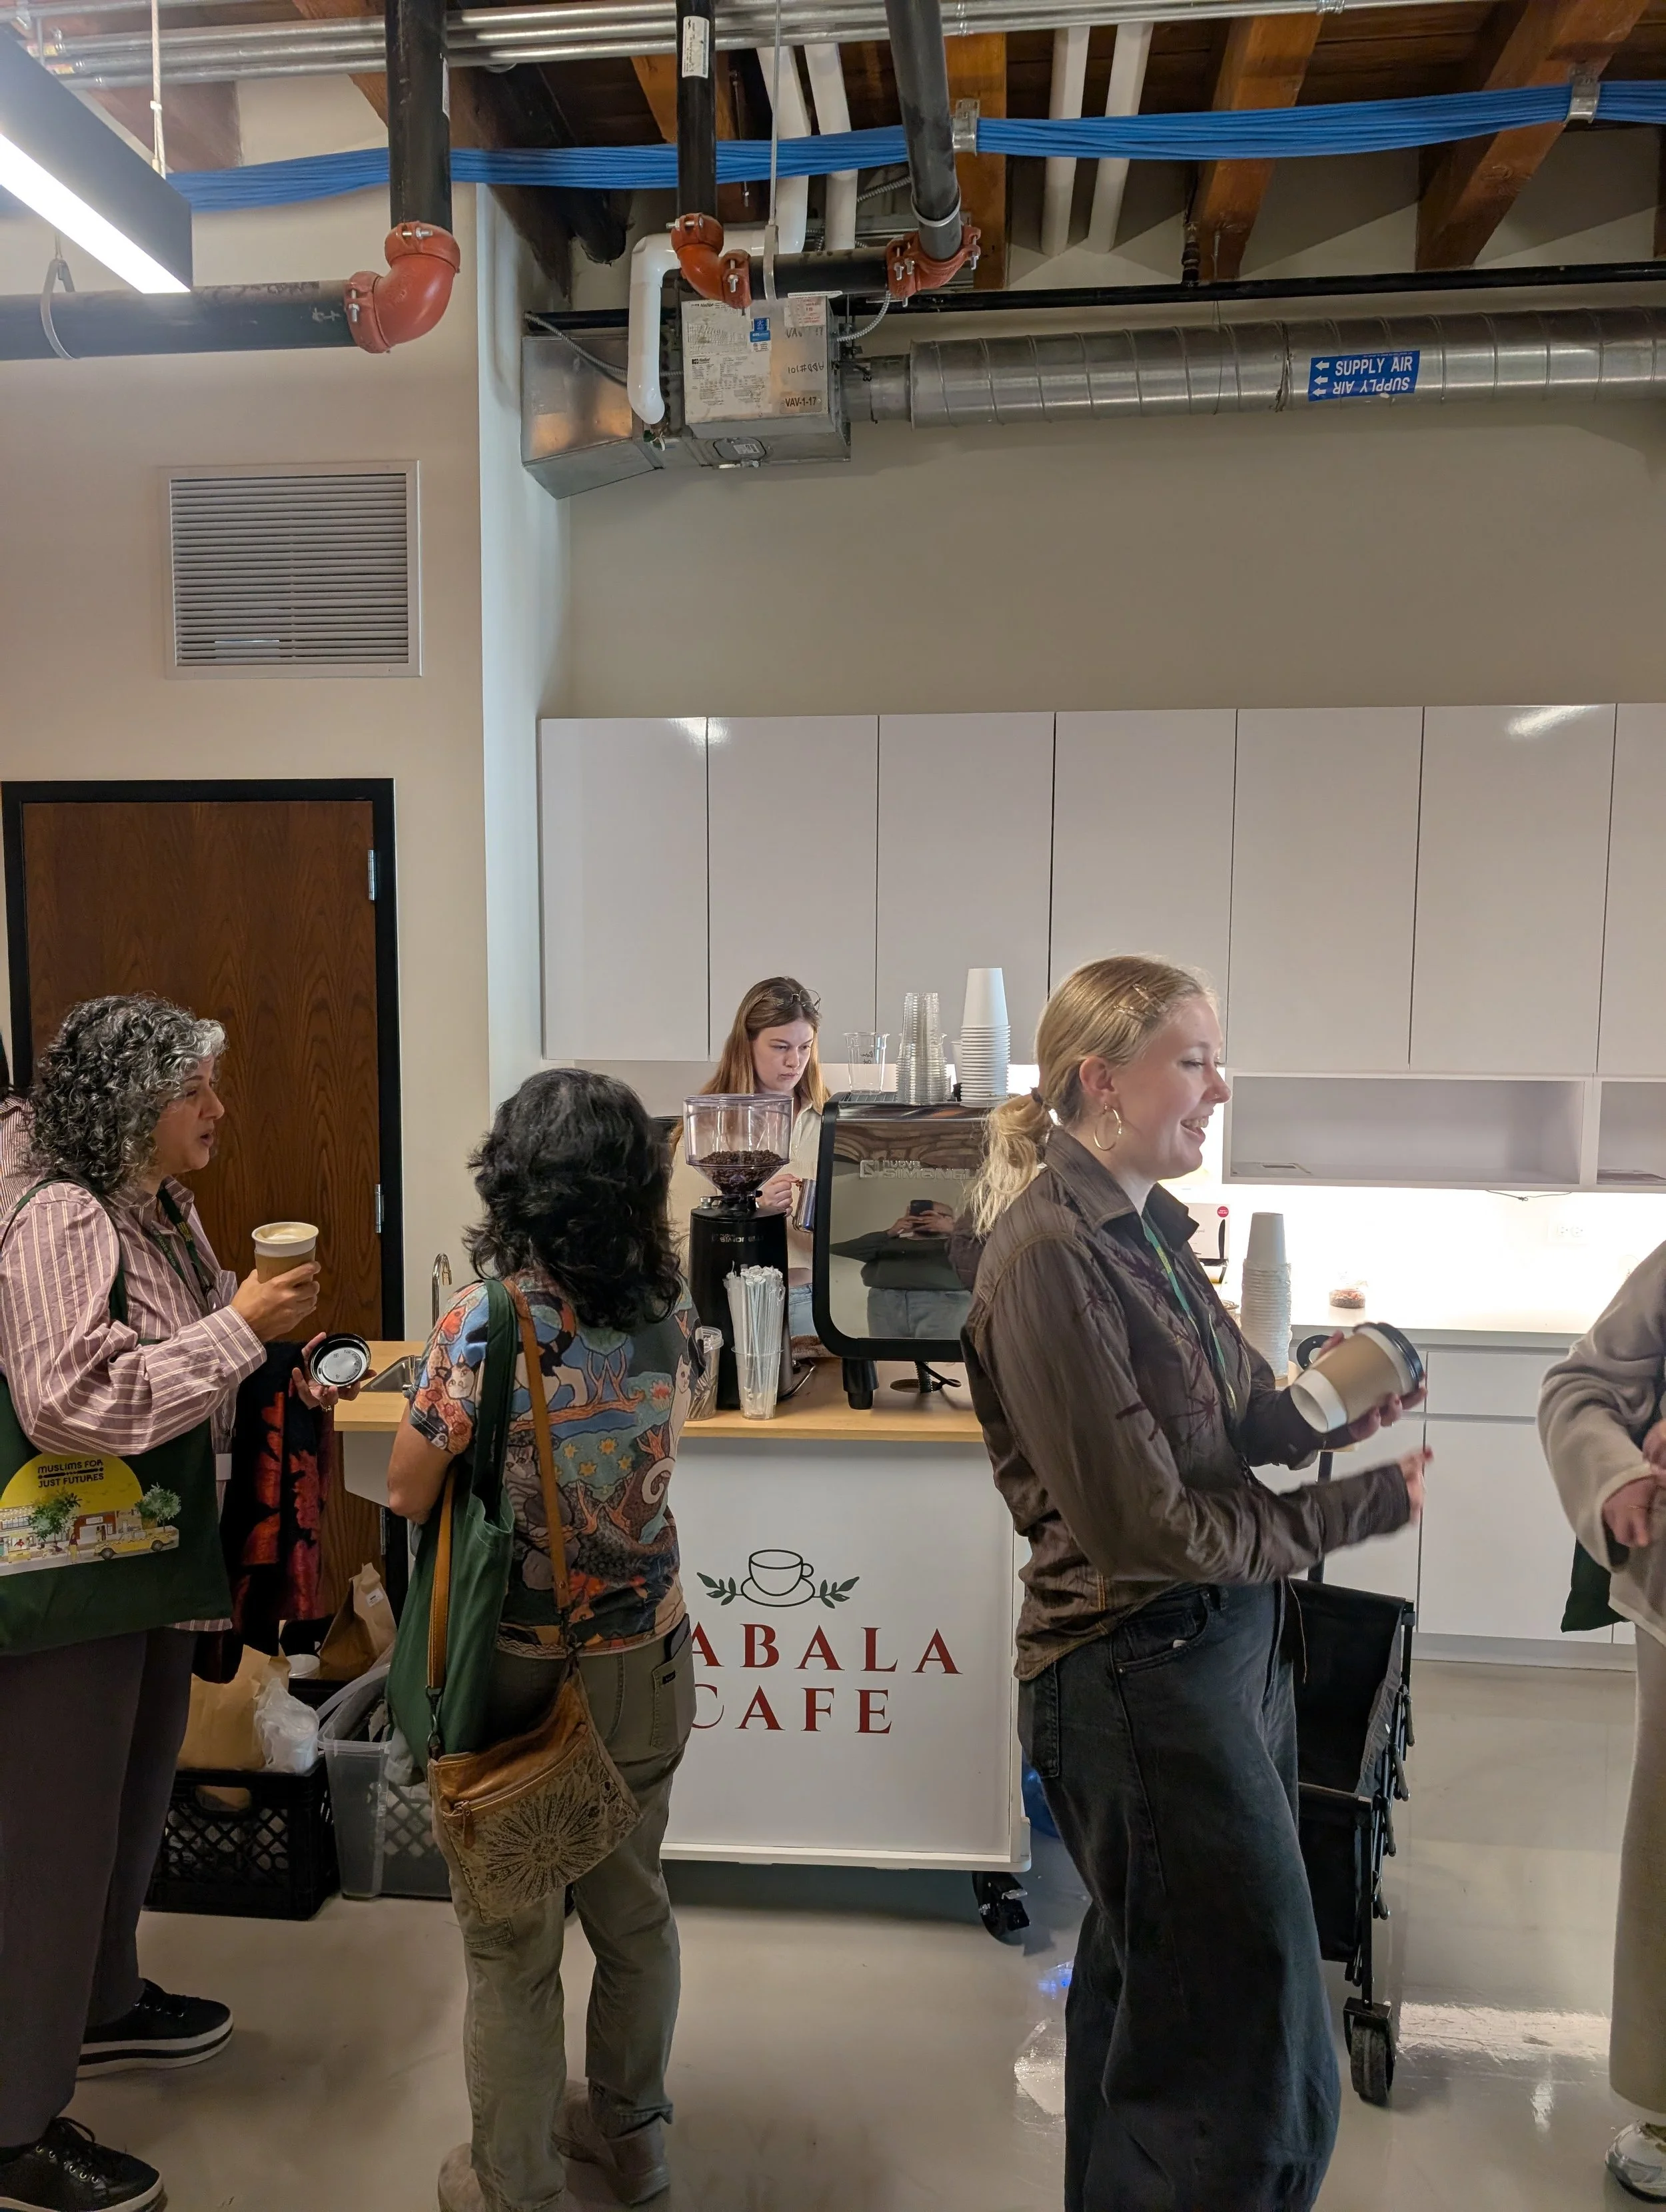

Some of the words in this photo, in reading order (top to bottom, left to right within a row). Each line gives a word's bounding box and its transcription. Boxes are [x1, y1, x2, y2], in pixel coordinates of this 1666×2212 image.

[1335, 358, 1385, 376] SUPPLY
[1390, 356, 1413, 372] AIR
[1333, 380, 1355, 394] AIR
[1359, 377, 1411, 393] SUPPLY
[785, 396, 817, 407] VAV-1-17
[882, 1160, 921, 1169] nuova
[37, 1461, 82, 1474] MUSLIMS
[84, 1458, 103, 1468] FOR
[38, 1478, 61, 1488] JUST
[63, 1472, 104, 1485] FUTURES
[692, 1621, 964, 1675] ABALA
[691, 1683, 892, 1734] CAFE
